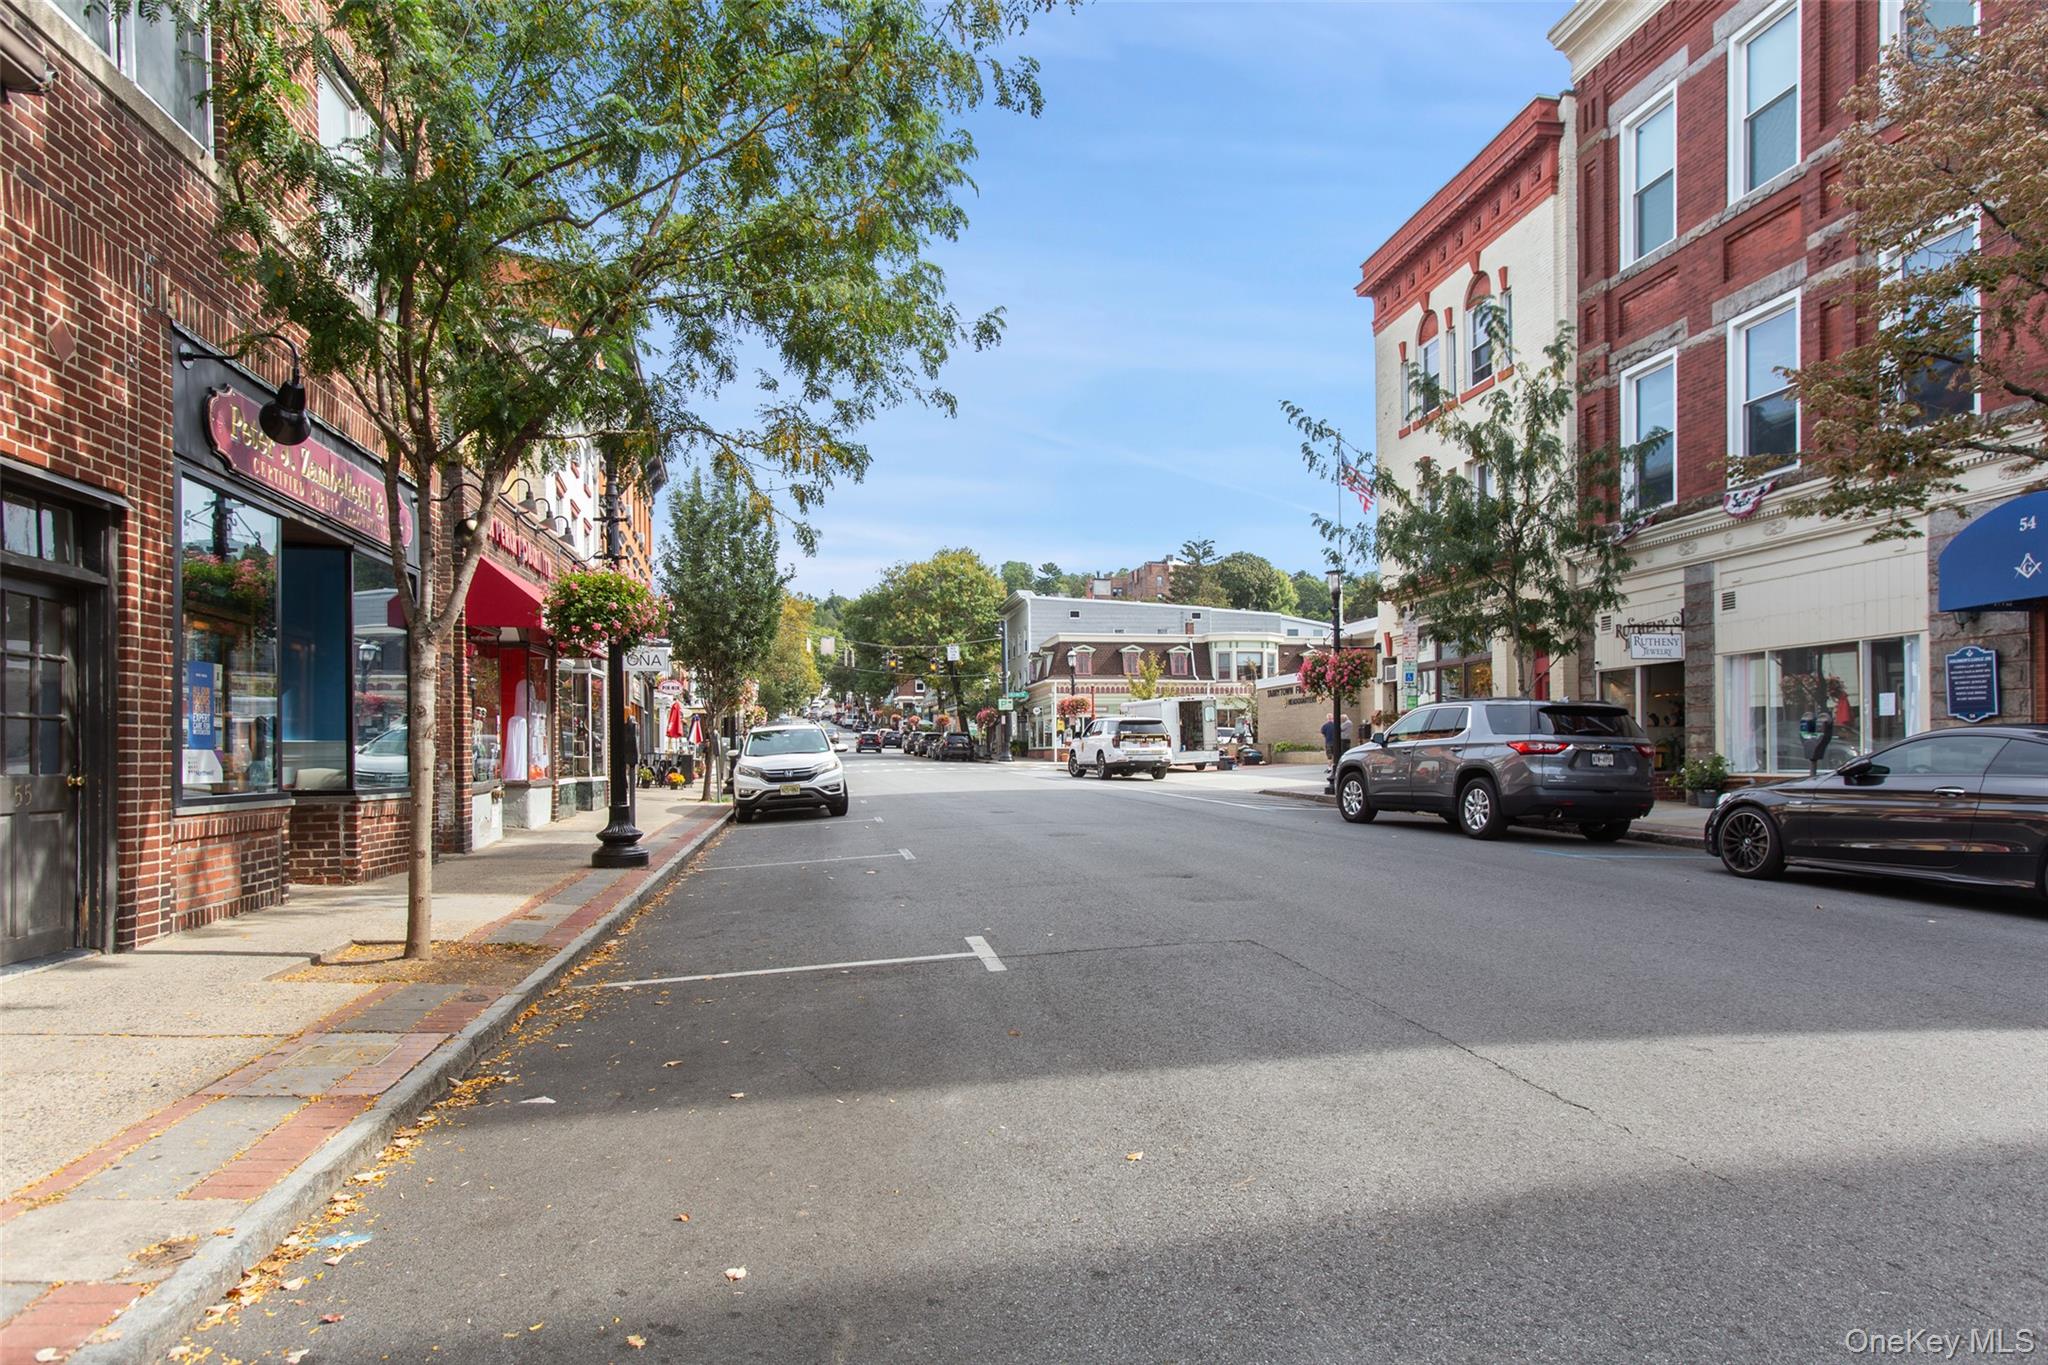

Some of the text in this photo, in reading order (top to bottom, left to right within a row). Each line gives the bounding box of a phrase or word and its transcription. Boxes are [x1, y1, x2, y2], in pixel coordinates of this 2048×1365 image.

[230, 405, 276, 459] Peter
[375, 492, 384, 521] &
[253, 456, 305, 498] CERTIFIED
[311, 486, 340, 515] PUBLIC
[2019, 515, 2036, 531] 54
[1634, 636, 1679, 649] RUTHENY
[627, 654, 662, 666] ONA
[1642, 648, 1672, 657] JEWELRY
[15, 783, 32, 808] 55
